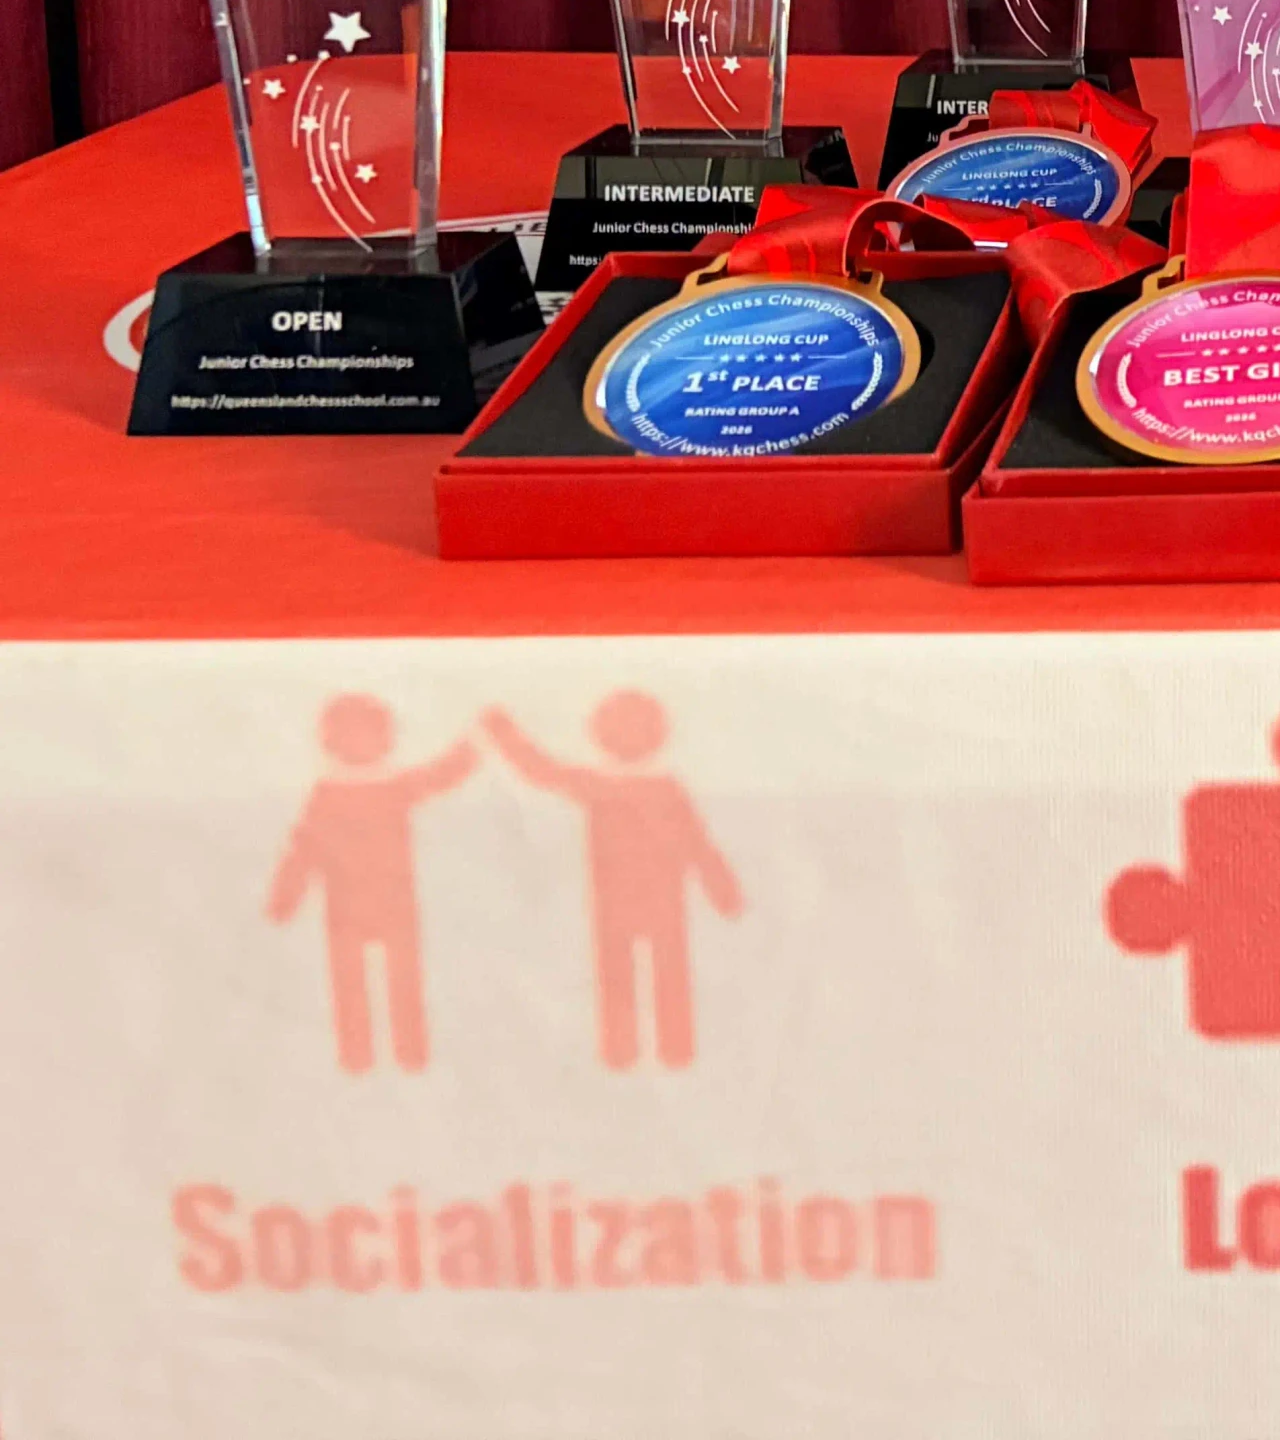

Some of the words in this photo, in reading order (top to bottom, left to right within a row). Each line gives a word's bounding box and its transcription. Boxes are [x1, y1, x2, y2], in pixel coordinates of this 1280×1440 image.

[962, 169, 1028, 181] LINGLONG
[1032, 168, 1057, 177] CUP
[604, 185, 755, 203] INTERMEDIATE
[593, 222, 631, 233] Junior
[633, 223, 669, 233] Chess
[272, 311, 342, 331] OPEN
[650, 314, 700, 347] Junior
[706, 297, 762, 317] Chess
[768, 295, 878, 347] Championships
[1128, 316, 1171, 348] Junior
[1176, 295, 1228, 317] Chess
[704, 335, 789, 345] LINGLONG
[795, 335, 828, 344] CUP
[1181, 327, 1268, 342] LINGLONG
[200, 355, 247, 370] Junior
[250, 355, 294, 368] Chess
[299, 355, 414, 371] Championships
[683, 369, 729, 393] 1st
[733, 376, 820, 391] PLACE
[1163, 366, 1239, 386] BEST
[170, 1180, 941, 1294] Socialization
